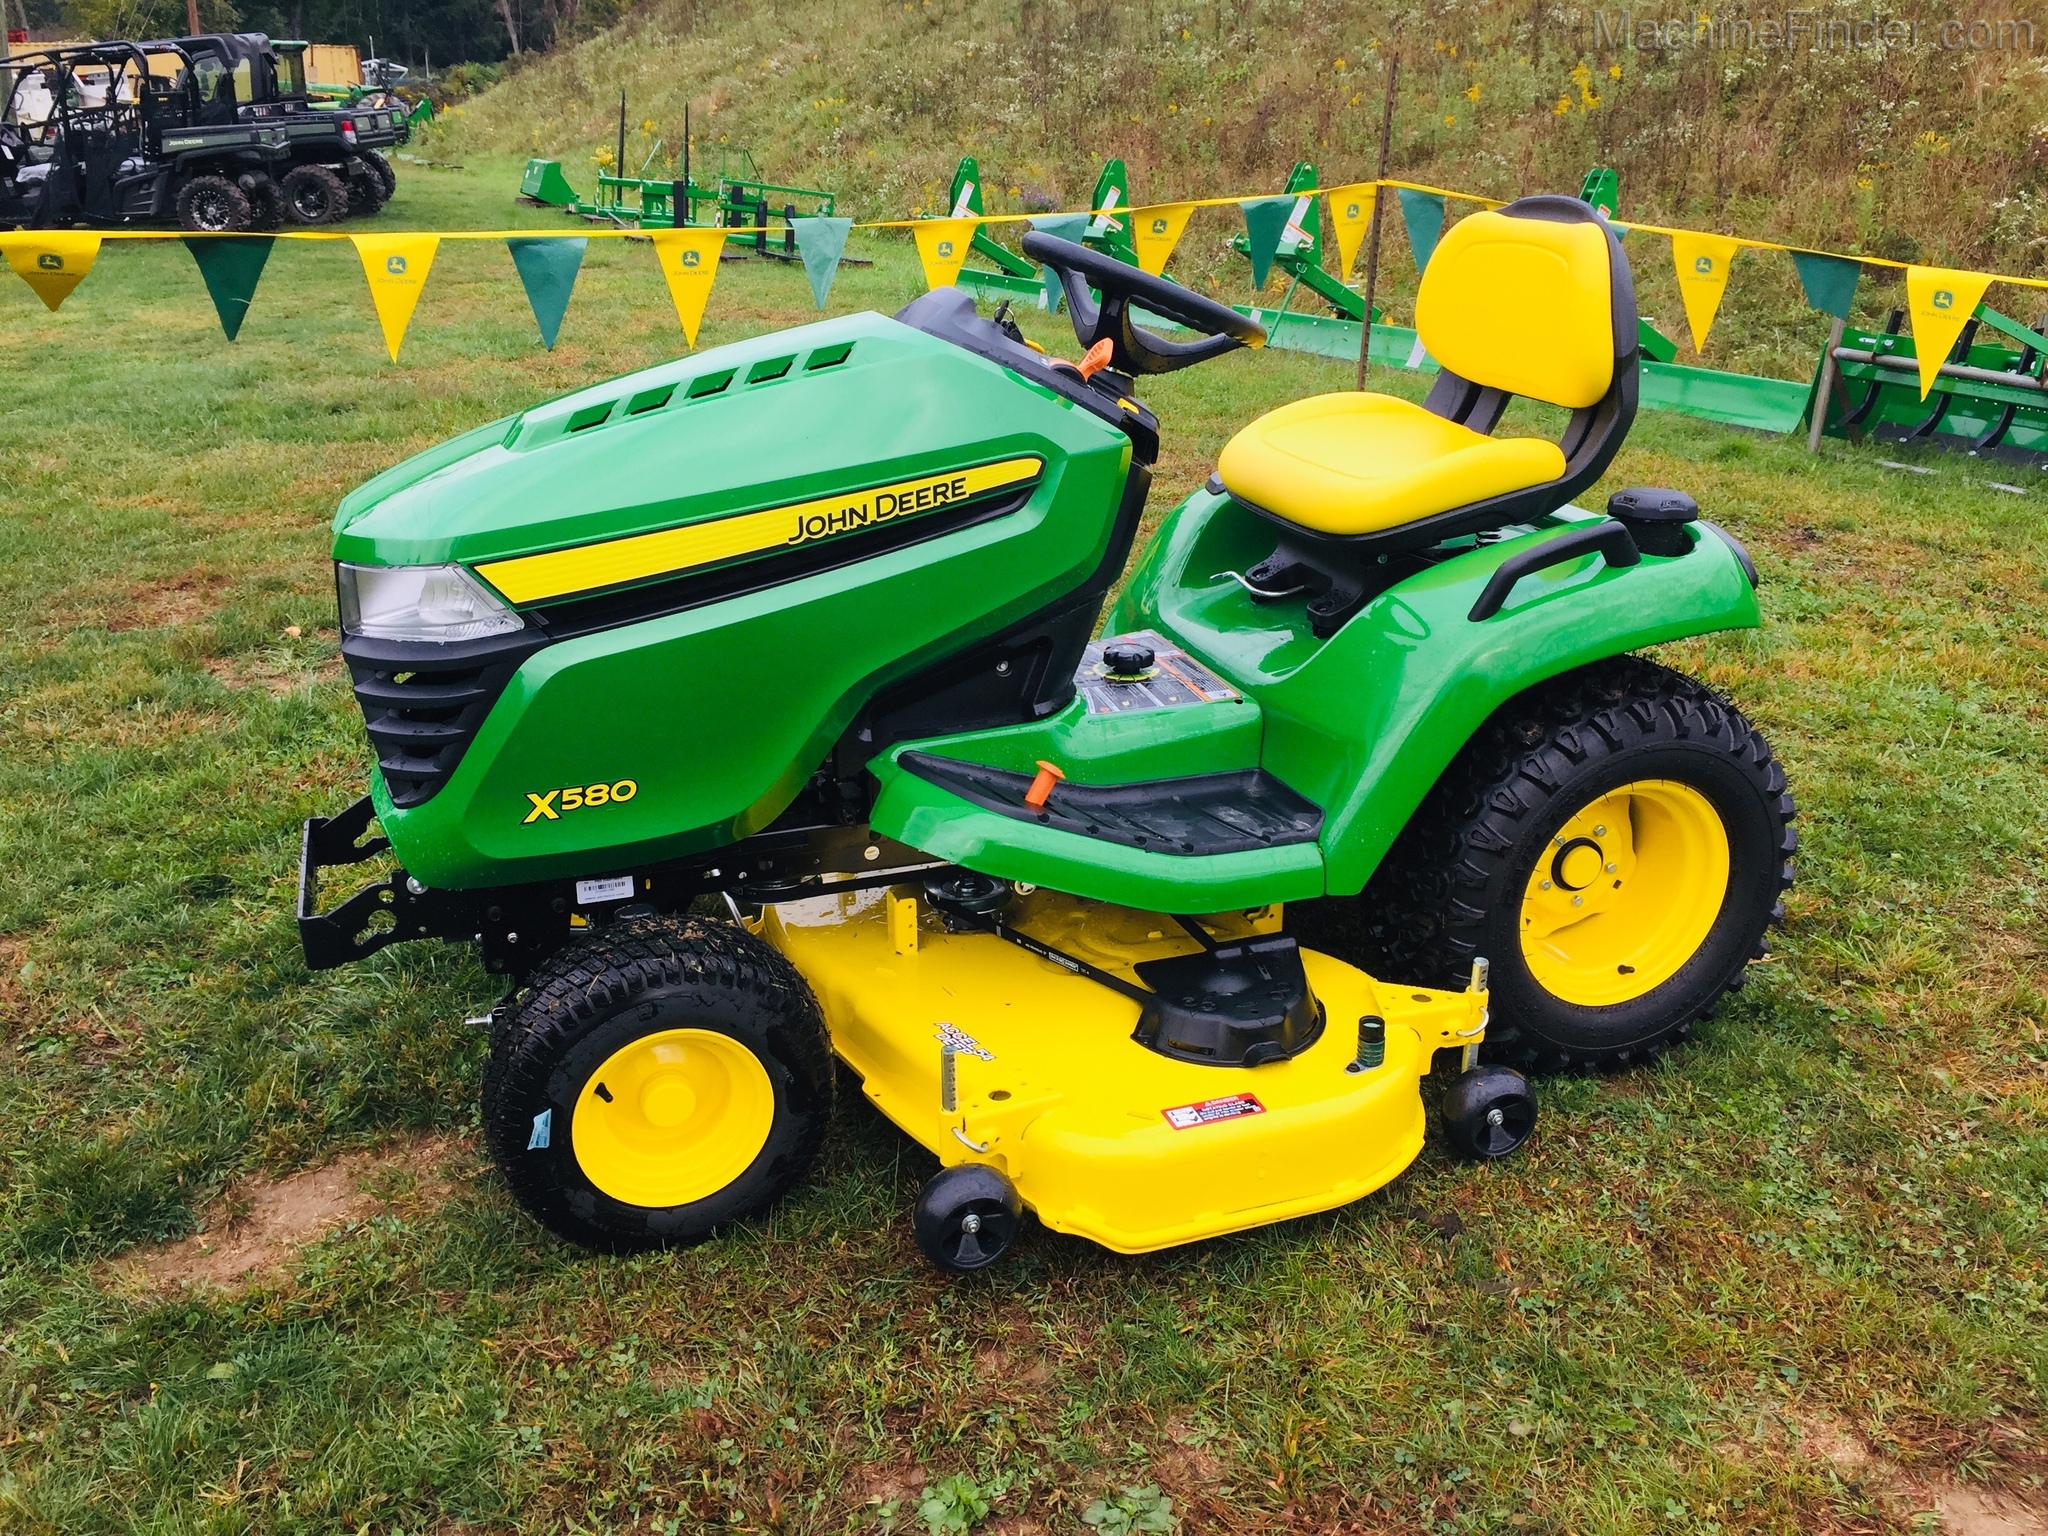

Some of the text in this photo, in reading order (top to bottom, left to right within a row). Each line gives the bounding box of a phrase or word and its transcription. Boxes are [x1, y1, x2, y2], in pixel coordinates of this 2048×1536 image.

[788, 476, 967, 543] JOHN DEERE
[521, 779, 638, 824] X580
